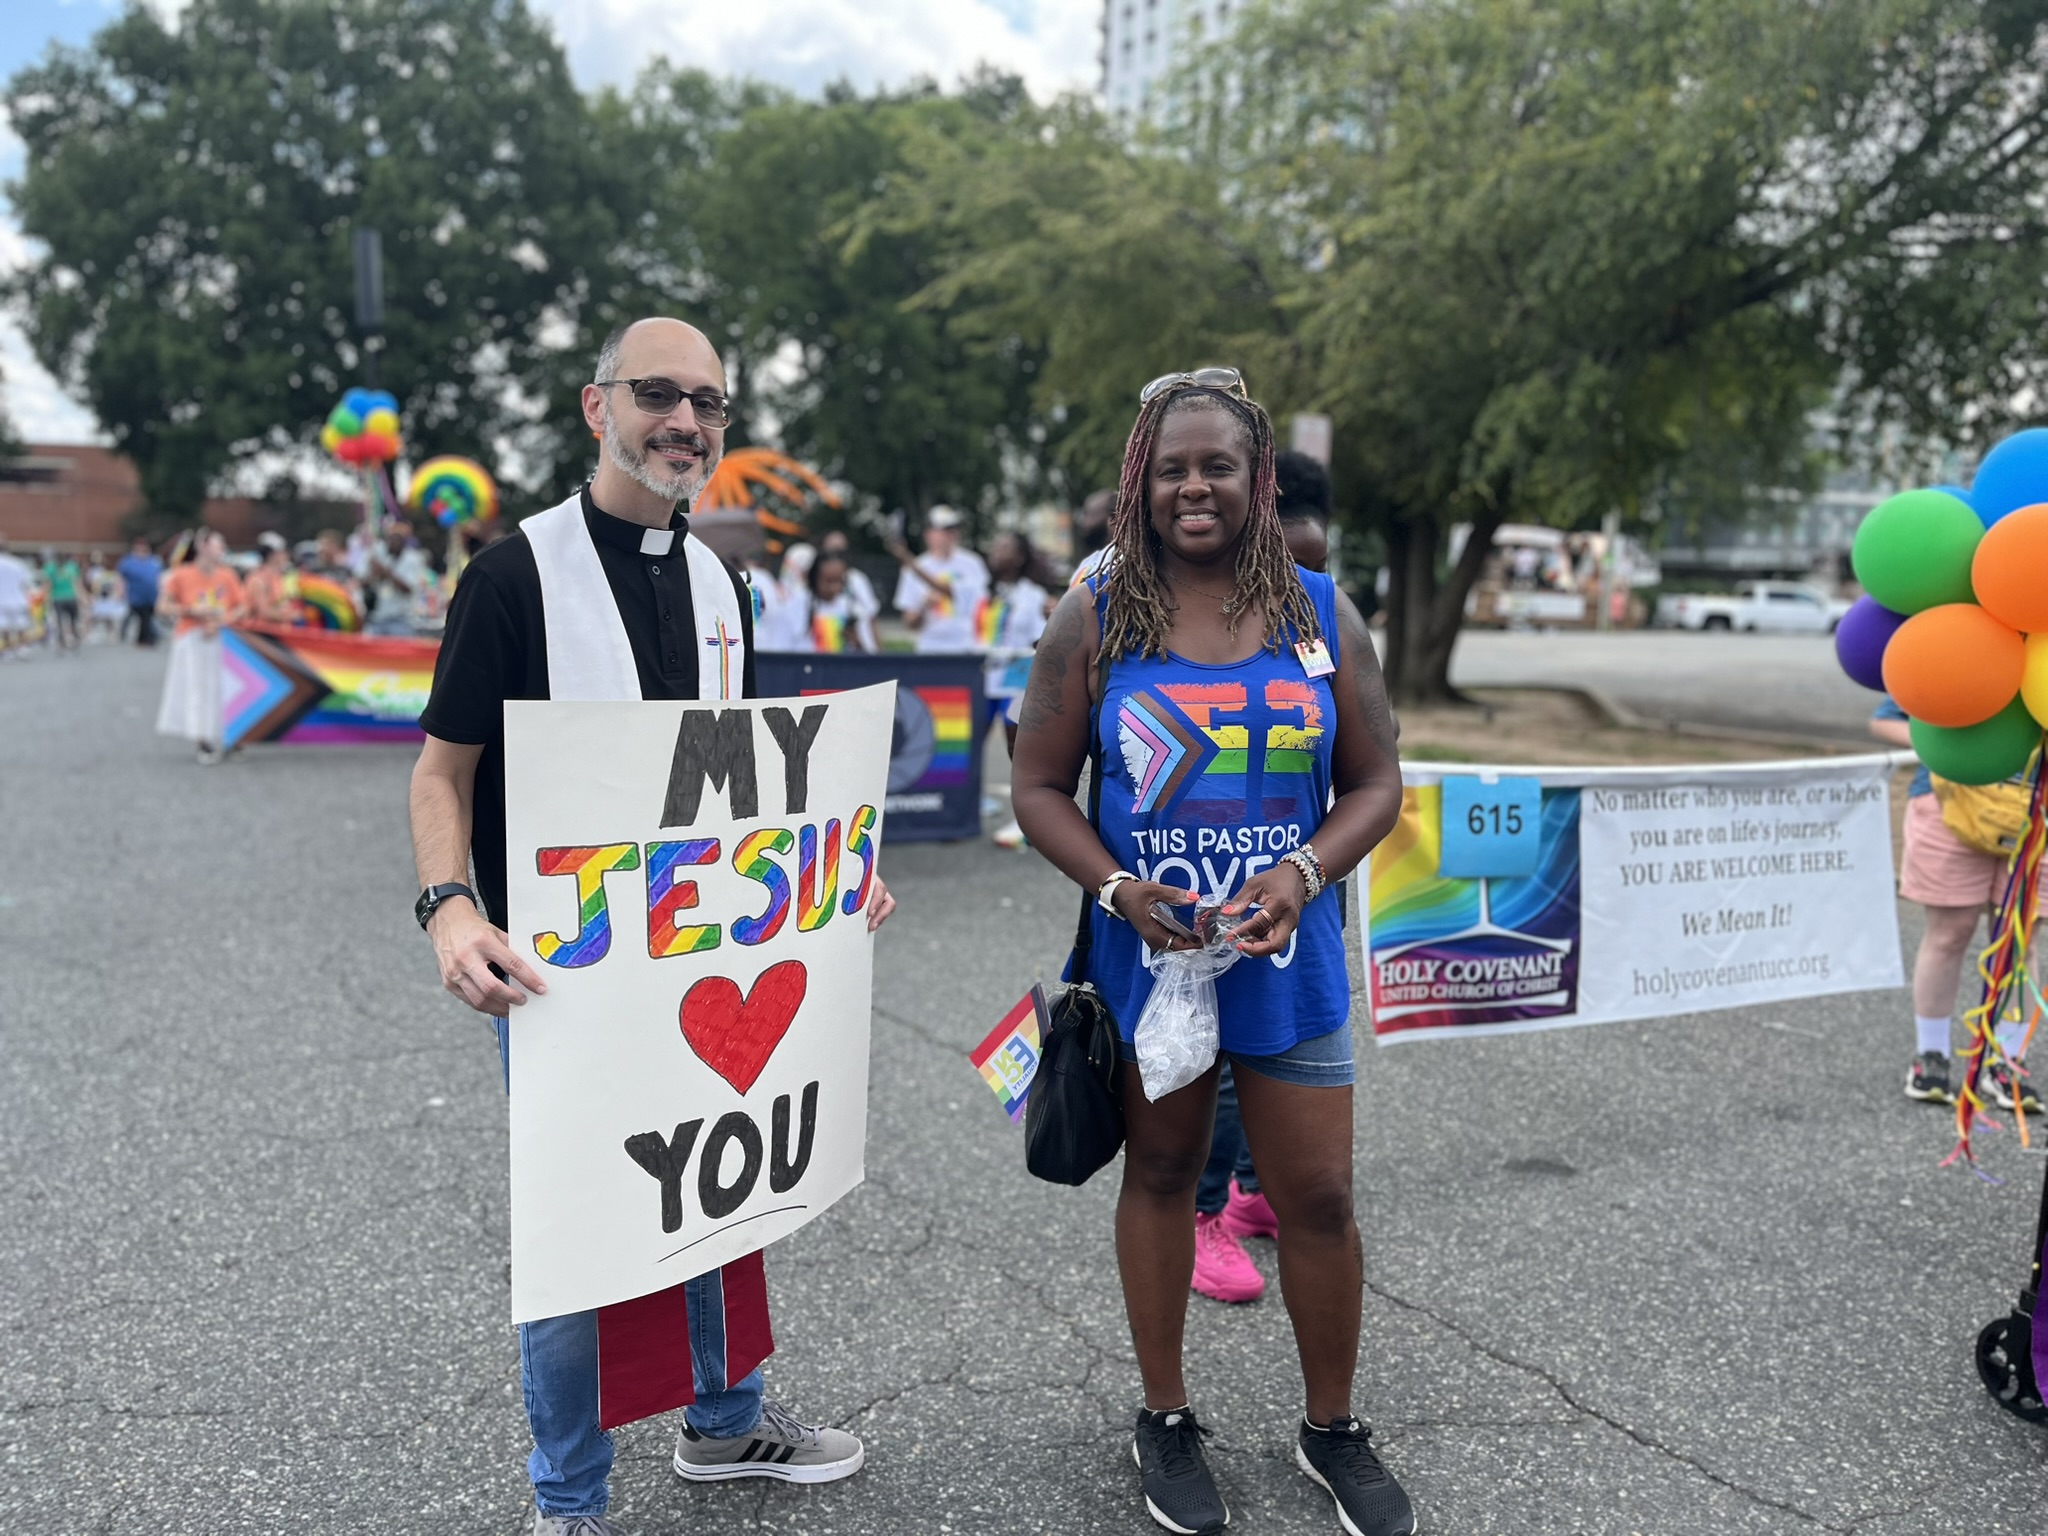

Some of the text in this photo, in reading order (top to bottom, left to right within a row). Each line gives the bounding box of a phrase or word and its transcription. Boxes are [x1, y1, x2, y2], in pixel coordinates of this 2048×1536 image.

[658, 704, 829, 829] MY
[1593, 789, 1619, 813] No
[1622, 789, 1689, 812] matter
[1693, 785, 1728, 809] who
[1730, 787, 1763, 813] you
[1806, 786, 1826, 804] or
[1829, 782, 1882, 804] where
[1467, 803, 1523, 836] 615
[1630, 818, 1843, 855] you are on life's journey,
[1131, 824, 1300, 855] THIS PASTOR
[532, 804, 877, 969] JESUS
[1620, 861, 1663, 887] YOU
[1669, 859, 1709, 884] ARE
[1711, 852, 1797, 880] WELCOME
[1682, 903, 1793, 937] We Mean It!
[1379, 952, 1565, 987] HOLY COVENANT
[1633, 953, 1831, 999] holycovenantucc.org
[1379, 975, 1562, 1004] UNITED CHURCH OF CHRIST
[624, 1081, 819, 1234] YOU
